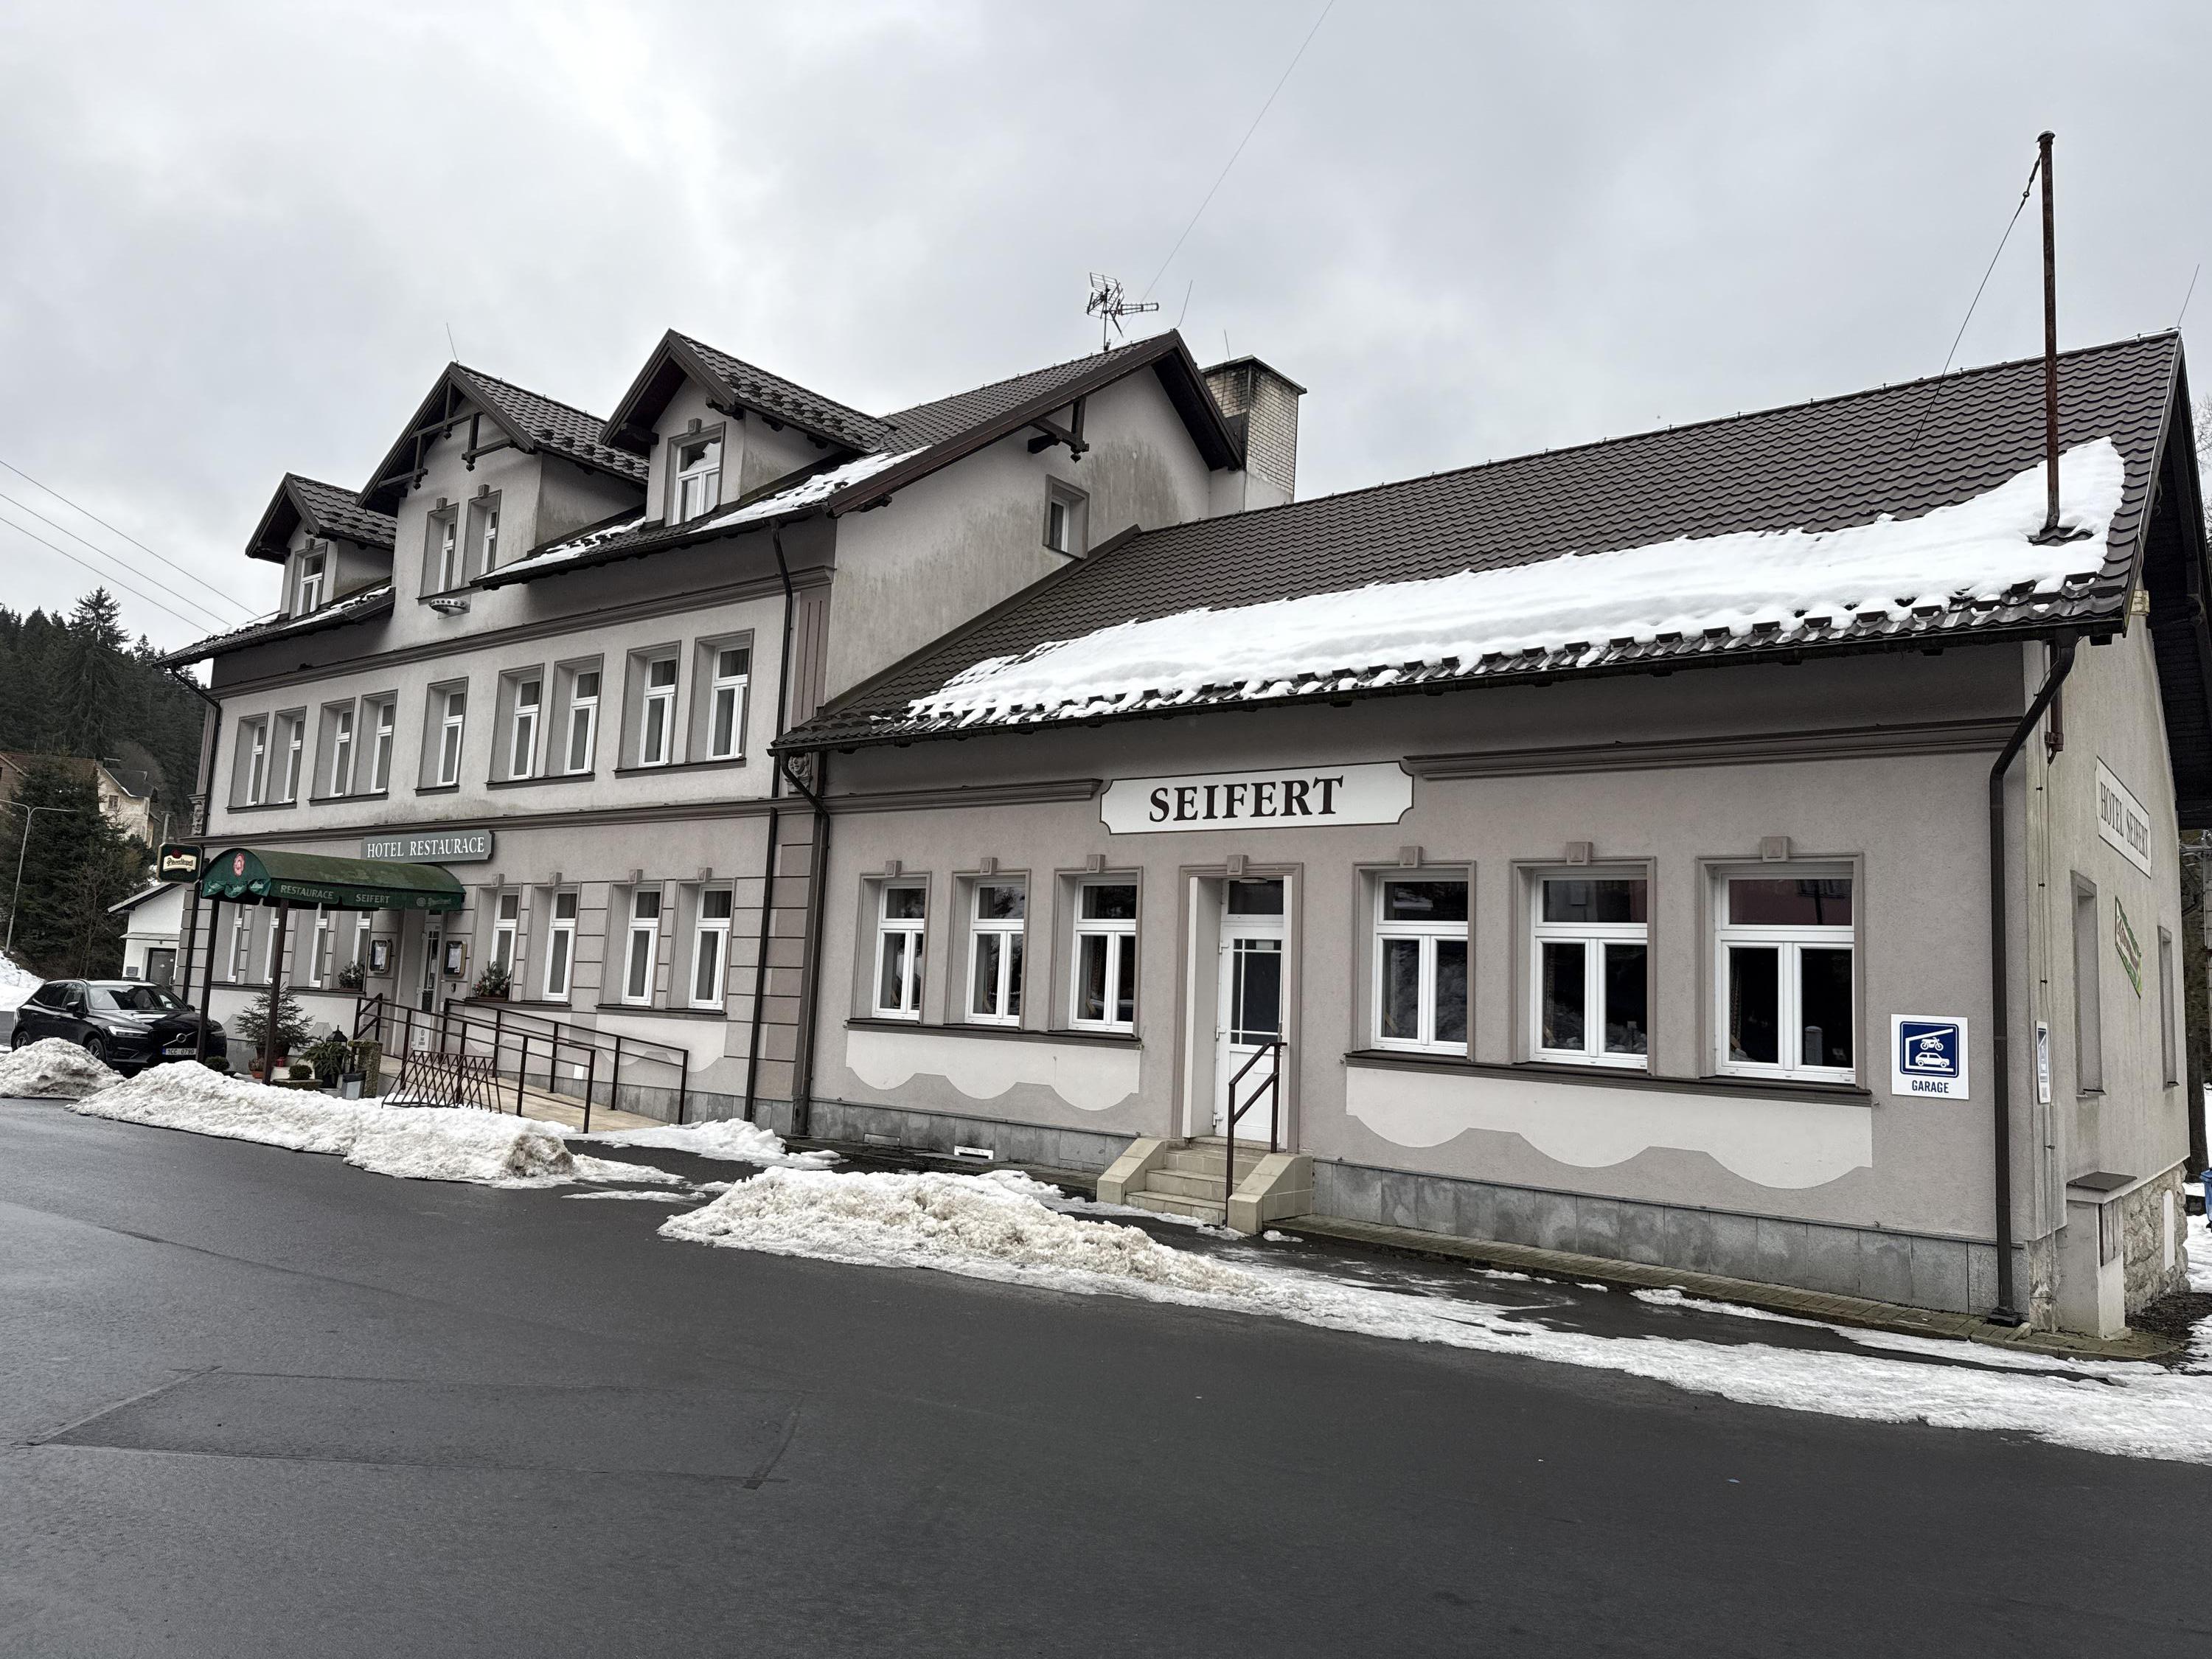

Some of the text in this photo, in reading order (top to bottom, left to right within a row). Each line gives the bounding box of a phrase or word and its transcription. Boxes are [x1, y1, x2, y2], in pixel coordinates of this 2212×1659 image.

[1149, 775, 1344, 822] SEIFERT
[2100, 782, 2149, 860] HOTEL SEIFERT
[367, 837, 484, 858] HOTEL RESTAURACE
[280, 884, 333, 900] RESTAURACE
[355, 893, 390, 904] SEIFERT
[1912, 1079, 1950, 1093] GARAGE
